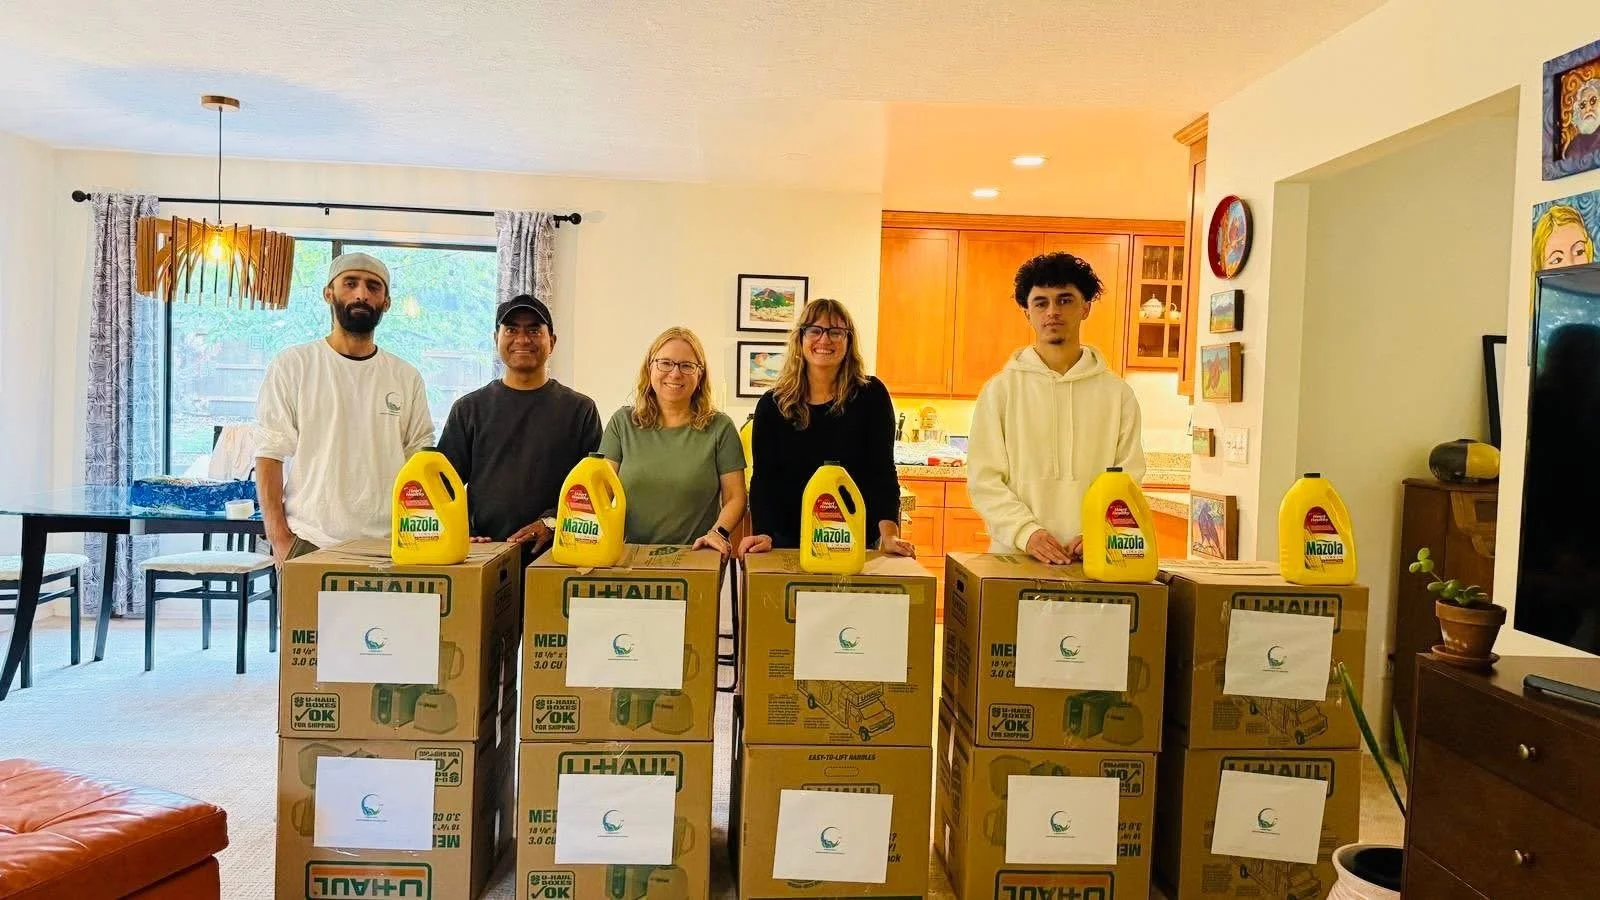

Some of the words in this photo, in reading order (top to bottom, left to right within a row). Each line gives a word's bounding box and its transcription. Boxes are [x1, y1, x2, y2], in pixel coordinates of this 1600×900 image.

[400, 517, 439, 532] Mazola
[563, 519, 598, 535] Mazola
[814, 529, 851, 543] Mazola
[1108, 535, 1144, 550] Mazola
[1306, 541, 1343, 556] Mazola
[572, 584, 679, 600] U-HAUL
[292, 630, 318, 644] ME
[991, 643, 1016, 657] ME
[292, 658, 307, 667] 3.0
[534, 661, 548, 670] 3.0
[551, 661, 563, 670] CU
[309, 709, 335, 722] OK
[549, 711, 575, 724] OK
[1005, 719, 1029, 732] OK
[567, 758, 675, 776] U-HAUL
[445, 812, 461, 822] 3.0
[529, 837, 543, 845] 3.0
[314, 877, 423, 897] U-HAUL
[544, 886, 570, 899] OK
